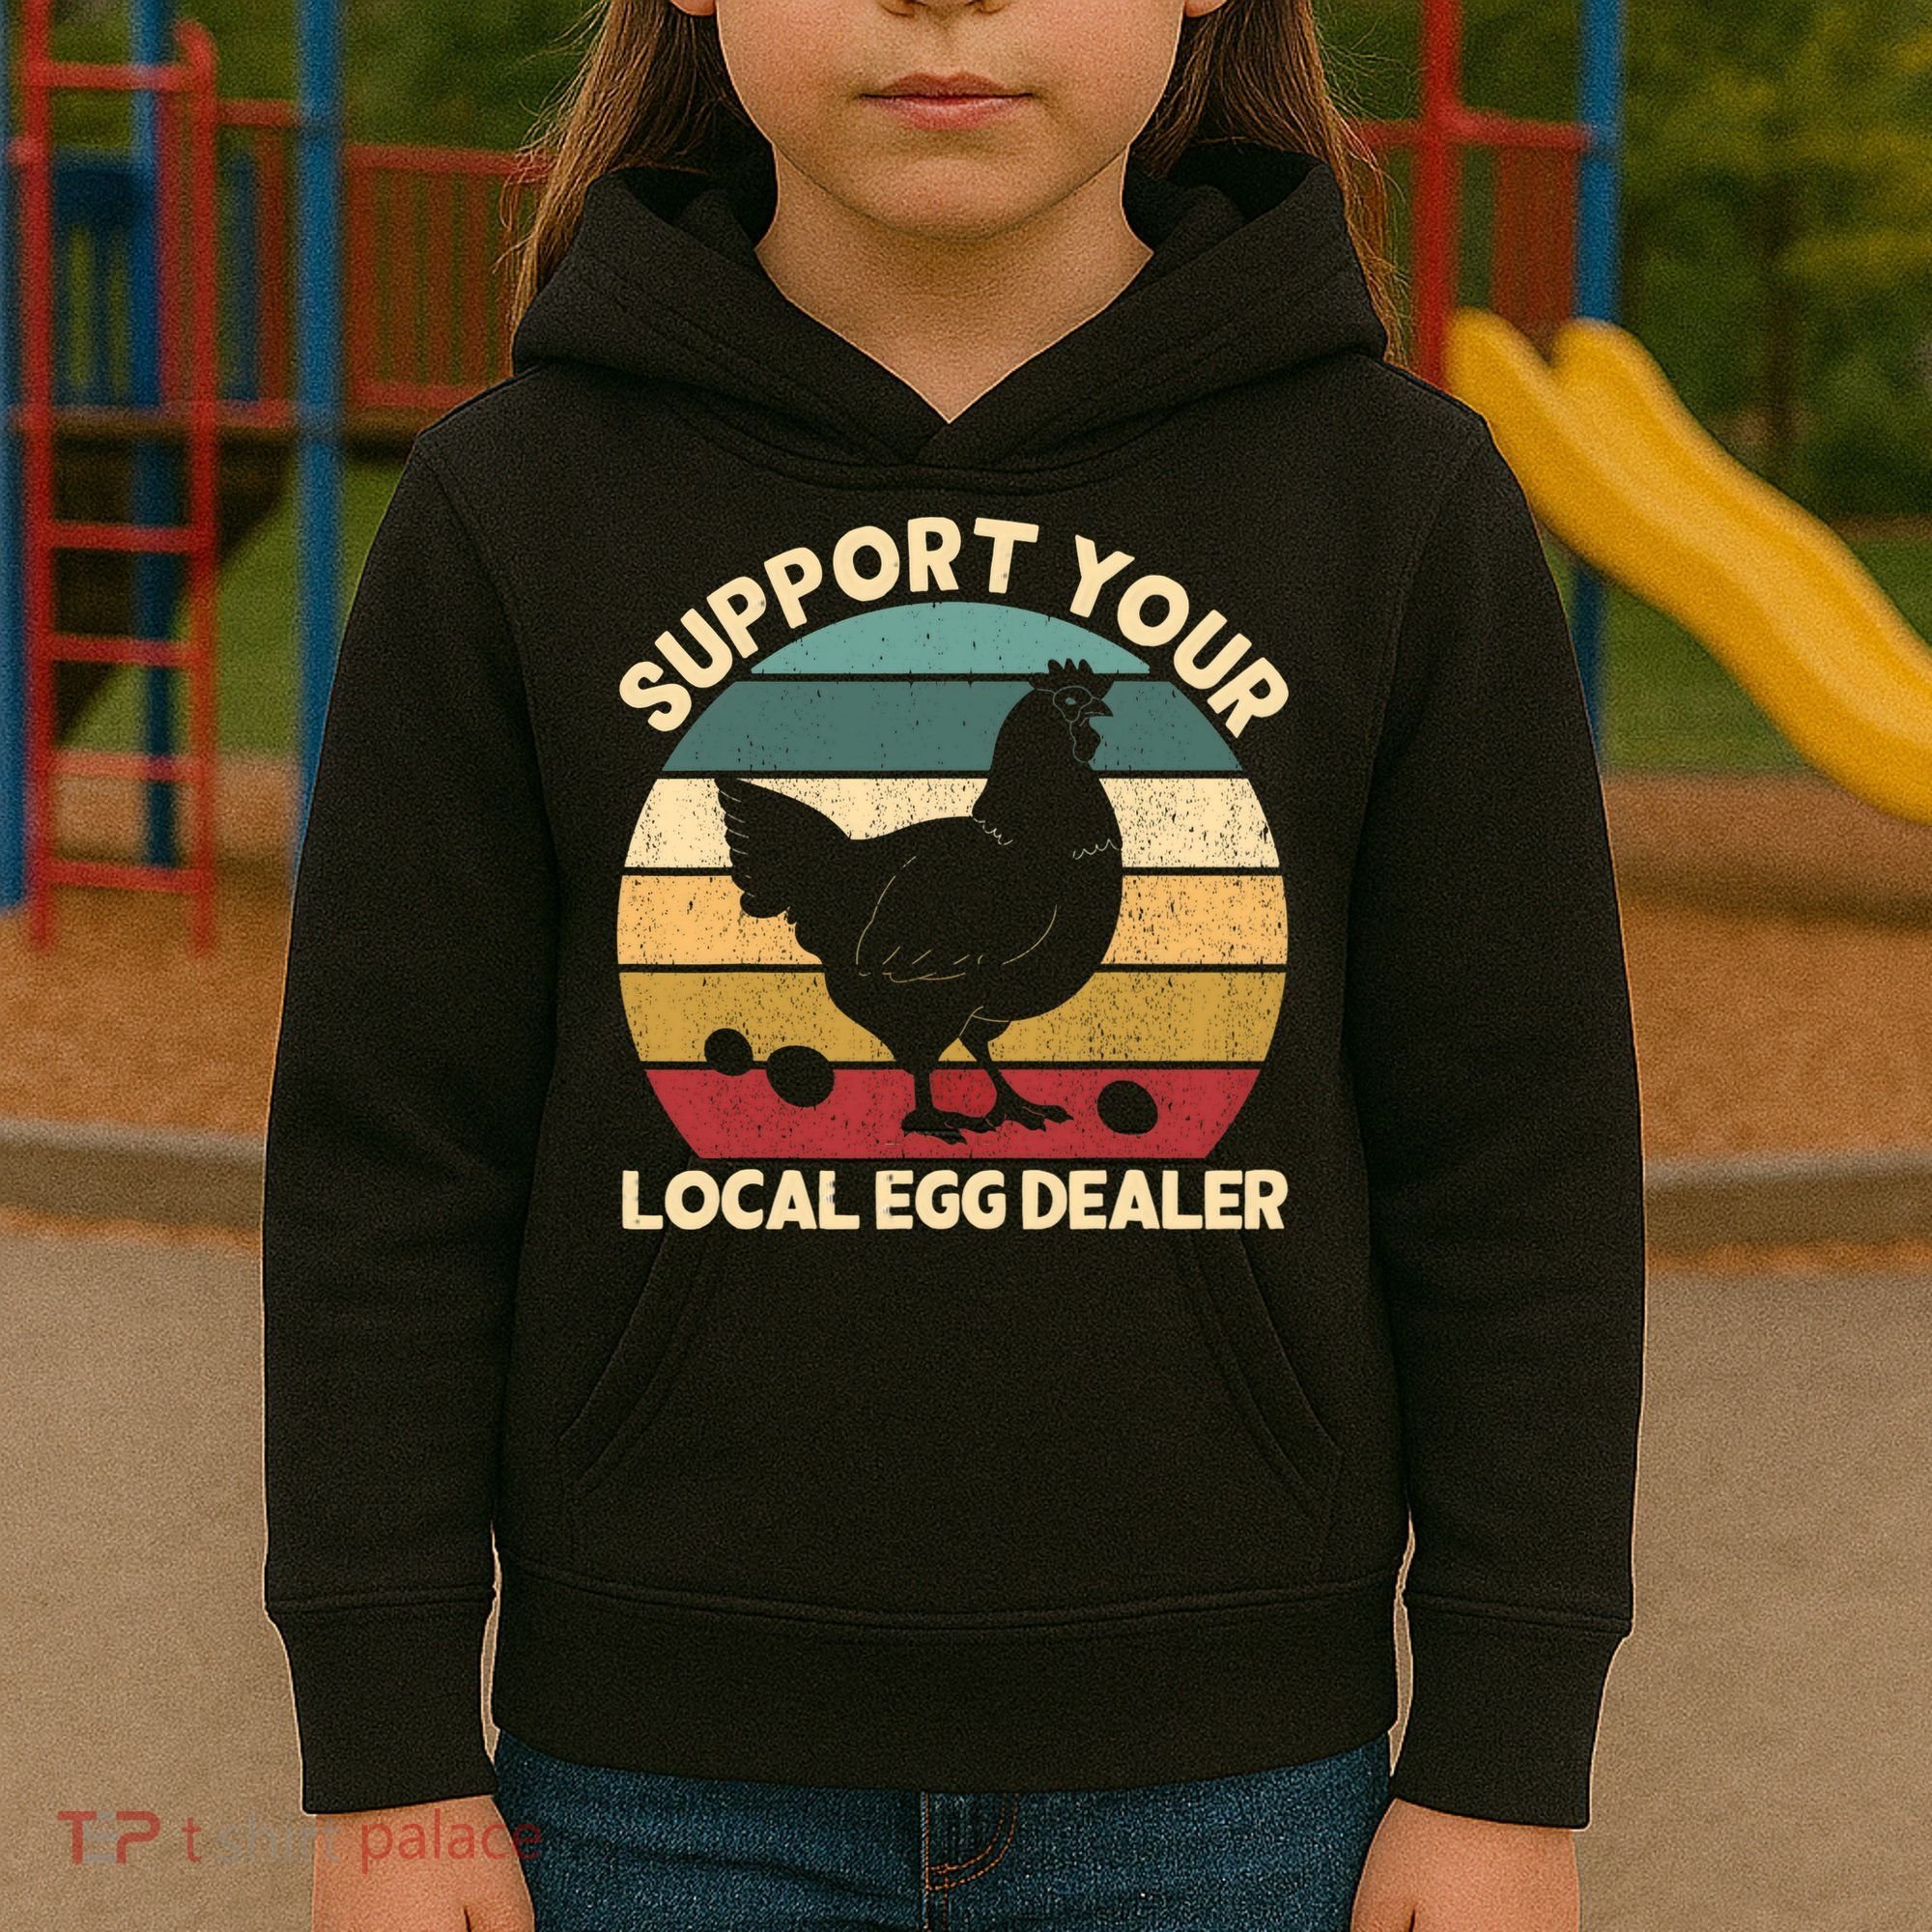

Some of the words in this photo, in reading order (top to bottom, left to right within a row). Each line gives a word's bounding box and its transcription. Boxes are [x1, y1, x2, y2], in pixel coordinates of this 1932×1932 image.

[619, 517, 1039, 732] SUPPORT
[1069, 534, 1289, 738] YOUR
[622, 1169, 860, 1230] LOCAL
[875, 1170, 1007, 1230] EGG
[1022, 1169, 1289, 1230] DEALER
